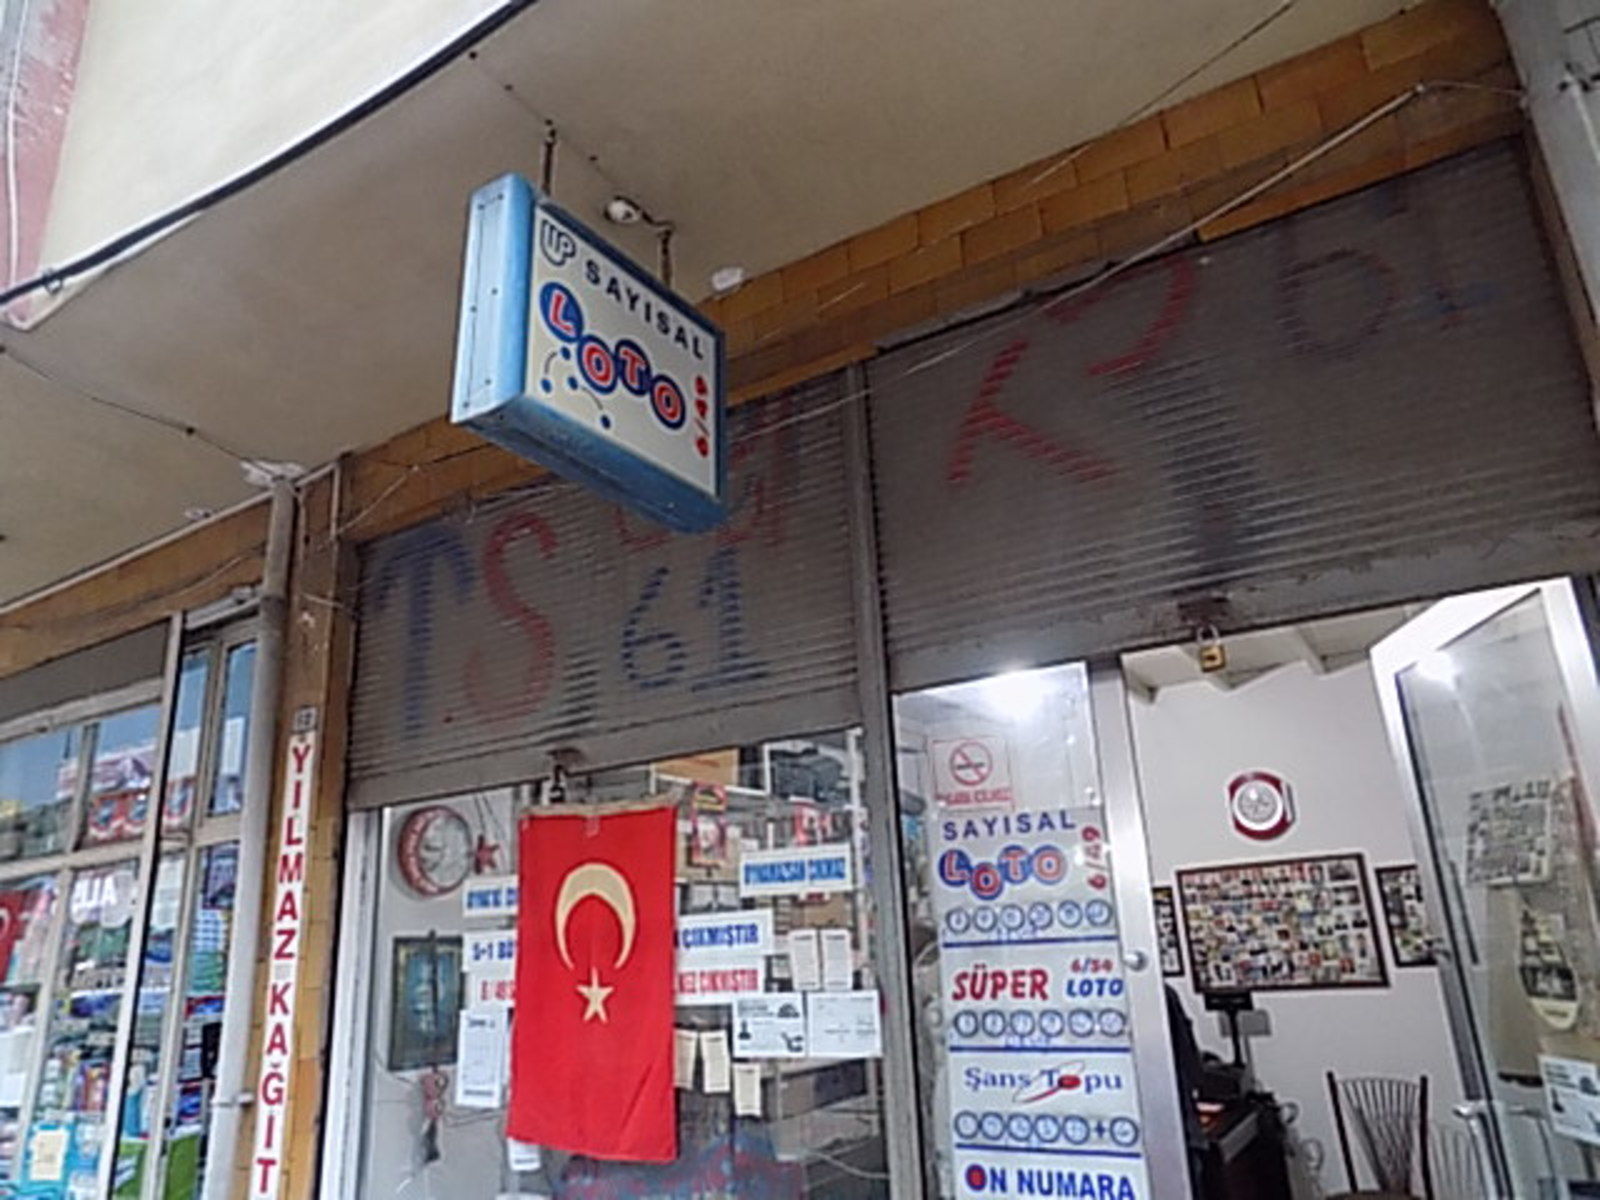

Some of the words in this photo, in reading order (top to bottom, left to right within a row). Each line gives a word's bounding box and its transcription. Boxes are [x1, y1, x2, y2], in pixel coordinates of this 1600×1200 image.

[585, 258, 704, 361] SAYISAL
[546, 288, 685, 425] LOTO
[619, 547, 771, 695] 61
[943, 809, 1076, 842] SAYISAL
[274, 744, 312, 961] YILMAZ
[940, 847, 1066, 899] LOTO
[951, 963, 1049, 1001] SÜPER
[1066, 978, 1124, 998] LOTO
[256, 983, 289, 1194] KAĞIT
[964, 1067, 1032, 1093] Şans
[965, 1164, 1007, 1195] ON
[1017, 1168, 1136, 1200] NUMARA
